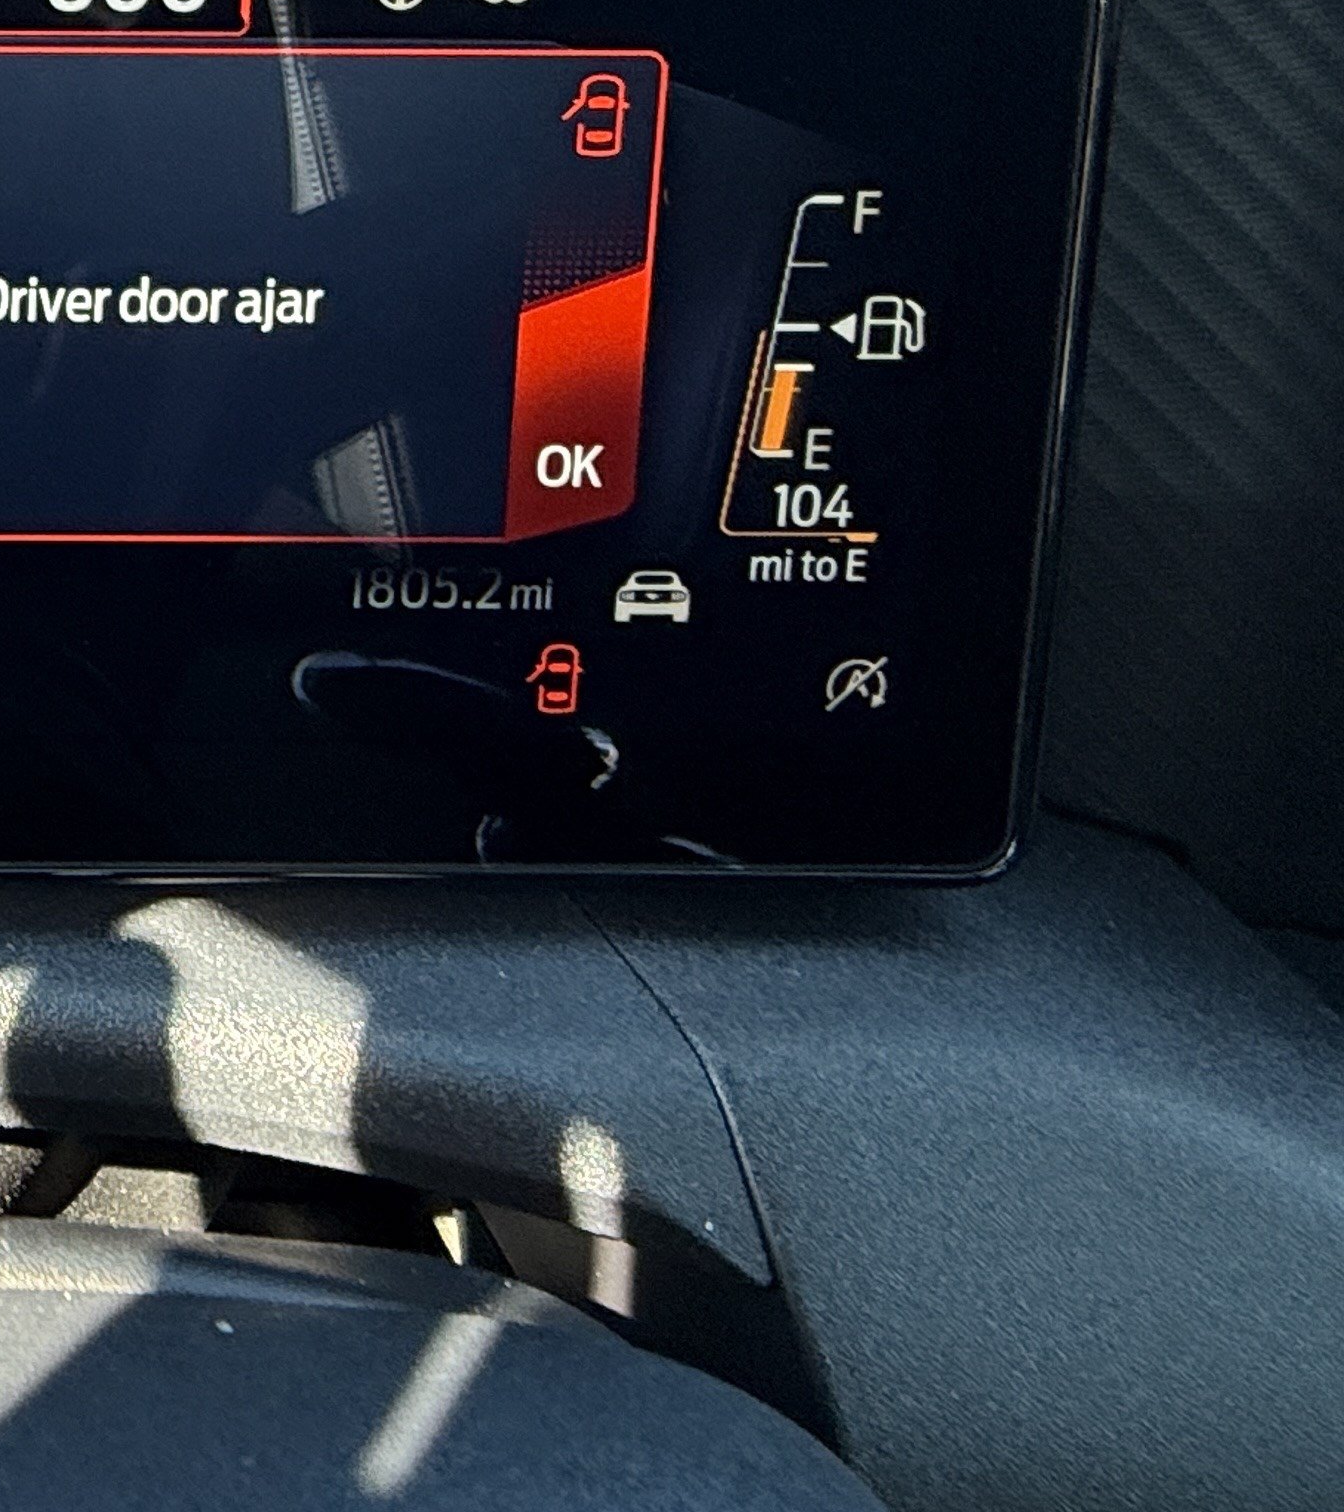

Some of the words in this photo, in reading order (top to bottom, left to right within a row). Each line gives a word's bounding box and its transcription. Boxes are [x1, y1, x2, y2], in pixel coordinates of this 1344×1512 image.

[853, 190, 883, 234] F
[118, 275, 229, 324] door
[234, 277, 325, 333] ajar
[537, 444, 604, 488] OK
[804, 428, 833, 471] E
[773, 483, 853, 528] 104
[749, 548, 793, 582] mi
[801, 550, 838, 582] to
[845, 548, 869, 582] E
[351, 567, 502, 610] 1805.2
[509, 577, 554, 610] mi
